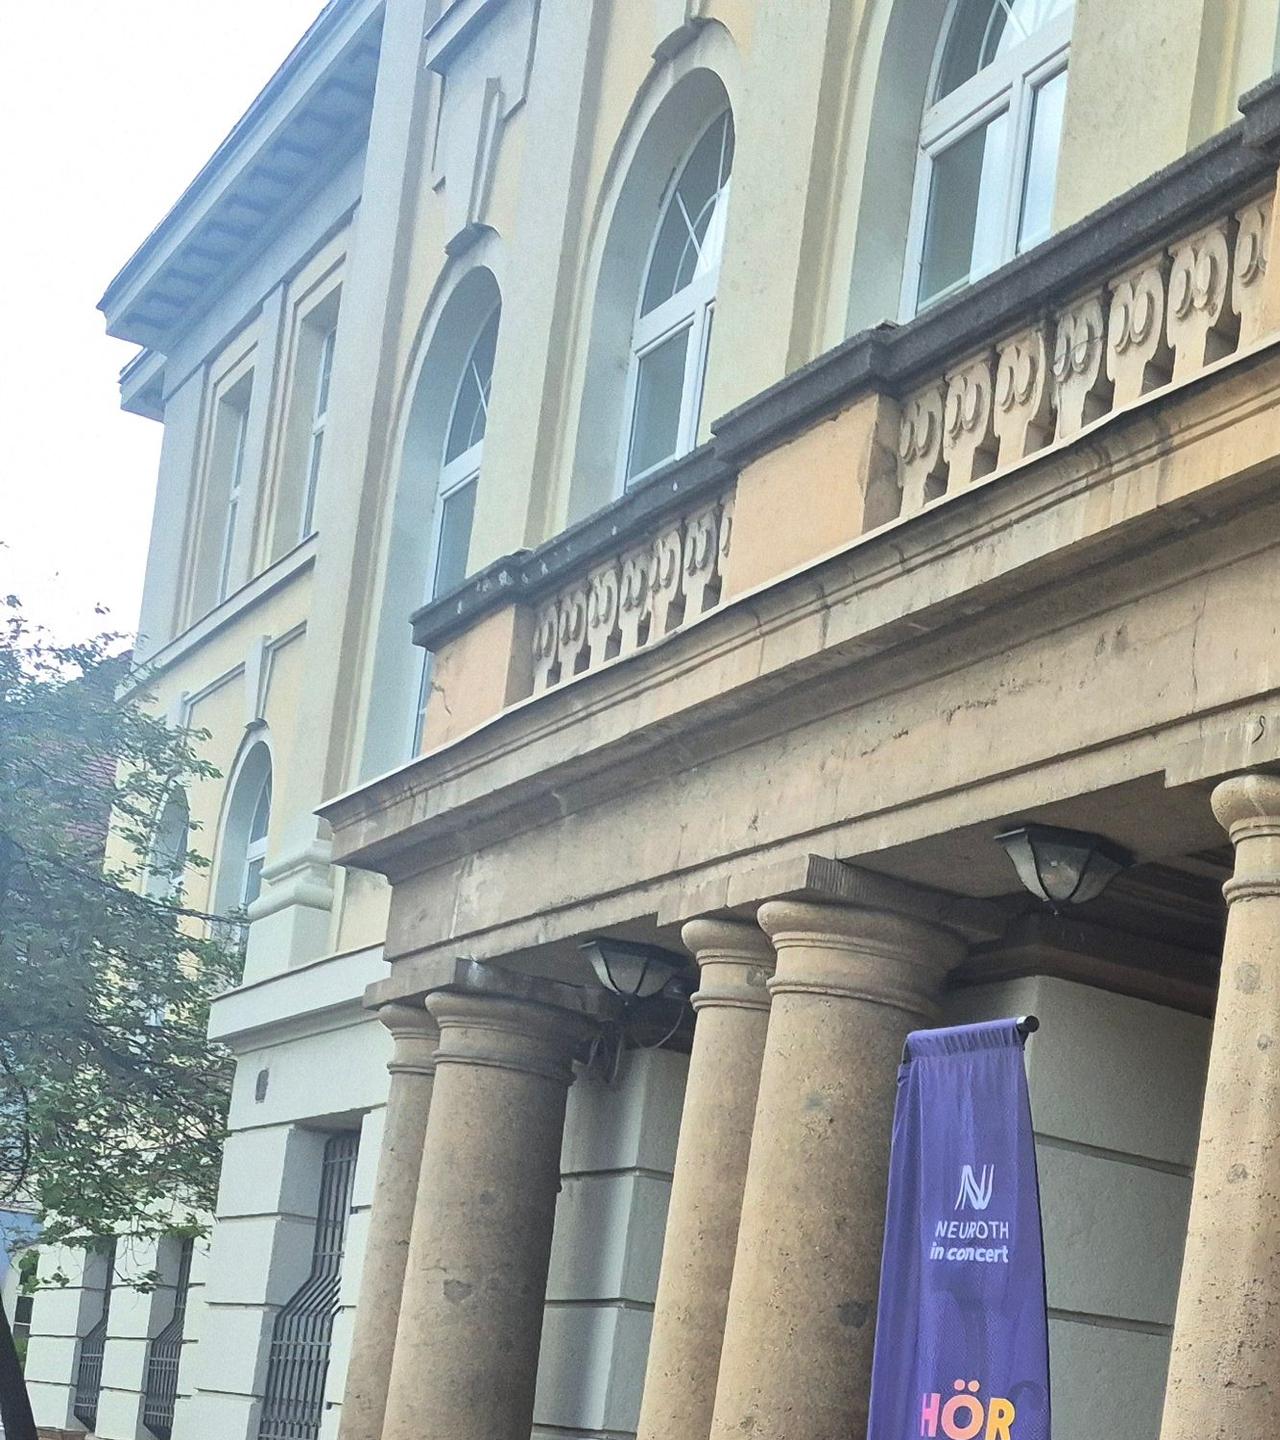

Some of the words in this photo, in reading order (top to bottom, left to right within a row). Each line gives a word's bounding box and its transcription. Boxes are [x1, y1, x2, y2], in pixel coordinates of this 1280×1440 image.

[935, 1220, 1009, 1239] NEUROTH
[929, 1241, 944, 1260] in
[946, 1245, 1009, 1263] concert
